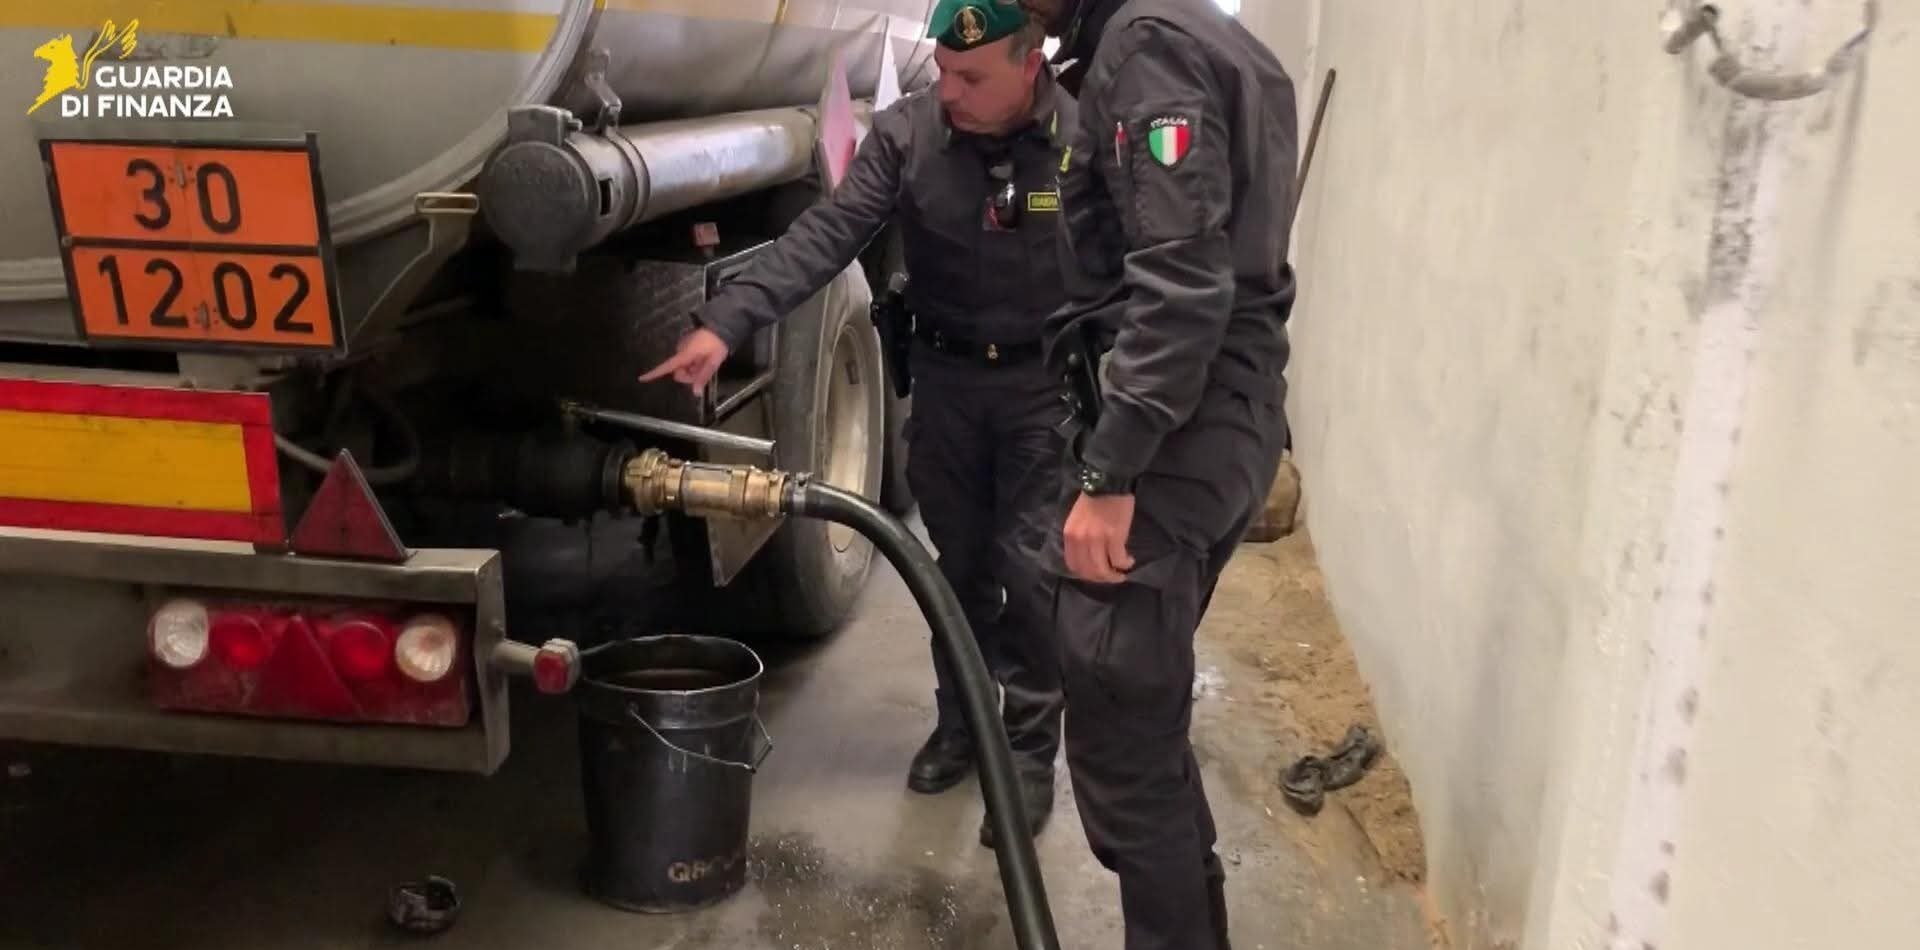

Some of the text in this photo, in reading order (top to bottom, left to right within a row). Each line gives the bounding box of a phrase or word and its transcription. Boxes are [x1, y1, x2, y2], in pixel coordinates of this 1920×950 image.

[1150, 117, 1188, 128] ITALIA
[126, 158, 242, 234] 30
[97, 255, 314, 334] 1202
